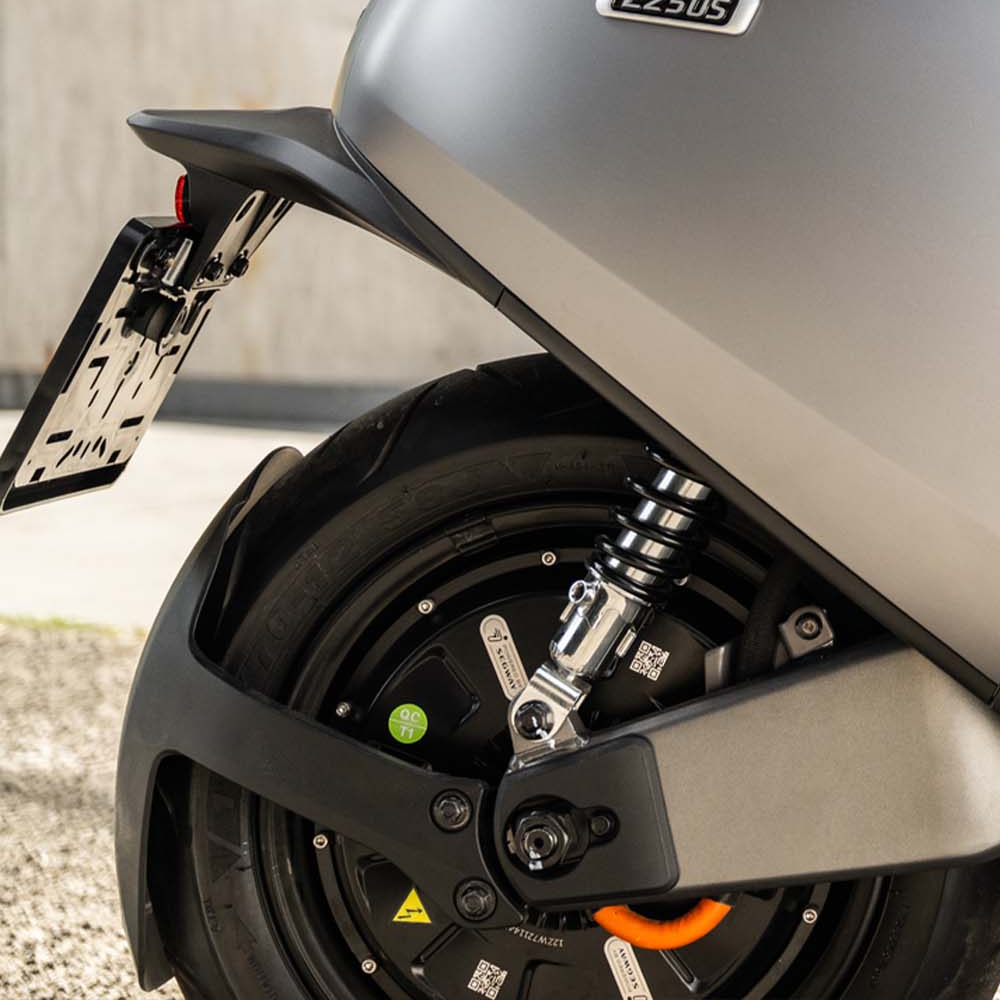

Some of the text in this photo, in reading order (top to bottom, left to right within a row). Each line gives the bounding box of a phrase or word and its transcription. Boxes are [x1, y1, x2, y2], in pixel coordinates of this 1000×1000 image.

[496, 648, 517, 689] SEGWAY
[399, 707, 420, 722] QC
[618, 948, 639, 990] SEGWAY
